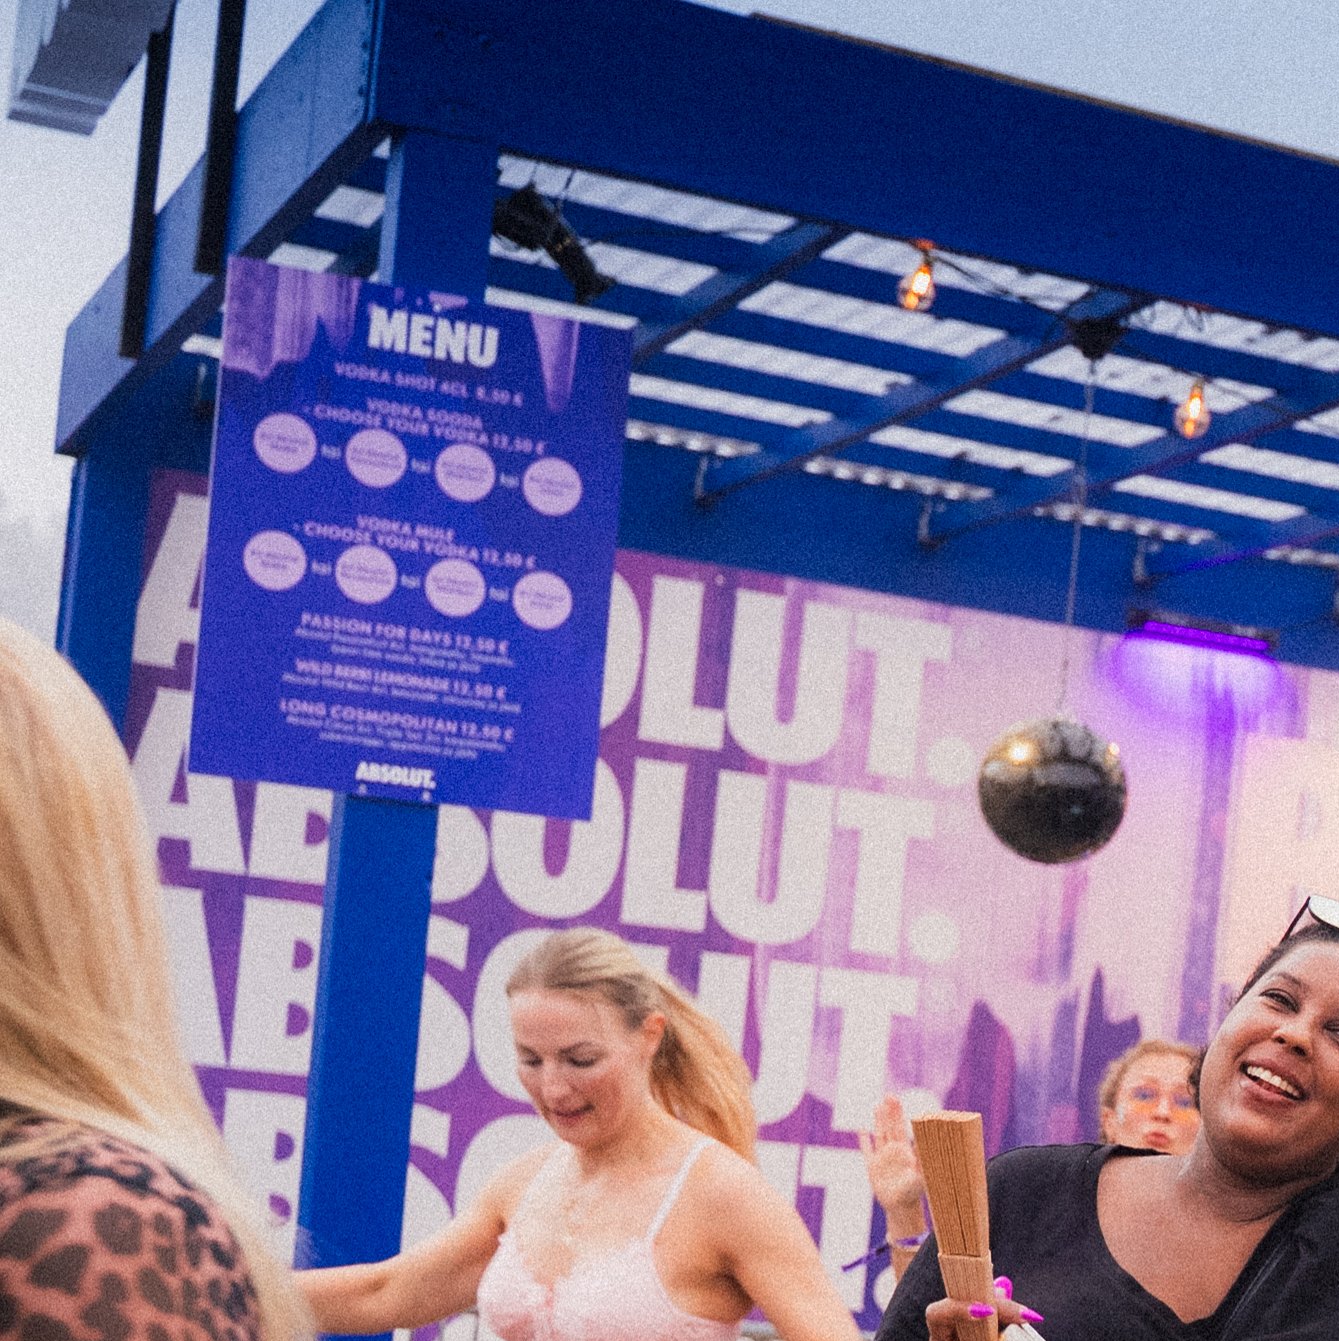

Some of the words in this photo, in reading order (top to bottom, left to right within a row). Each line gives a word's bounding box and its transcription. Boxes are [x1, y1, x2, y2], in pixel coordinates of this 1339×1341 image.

[367, 304, 499, 368] MENU
[334, 361, 391, 384] VODKA
[394, 370, 436, 392] SHOT
[313, 403, 382, 428] CHOOSE
[388, 414, 430, 436] YOUR
[433, 423, 490, 446] VODKA
[366, 398, 423, 421] VODKA
[303, 520, 372, 545] CHOOSE
[377, 532, 420, 553] YOUR
[424, 540, 479, 563] VODKA
[357, 514, 412, 537] VODKA
[415, 521, 456, 543] MULE
[301, 611, 372, 635] PASSION
[375, 623, 407, 641] FOR
[409, 628, 452, 647] DAYS
[295, 658, 332, 676] WILD
[279, 697, 327, 718] LONG
[330, 703, 457, 735] COSMOPOLITAN
[355, 761, 437, 789] ABSOLUT.
